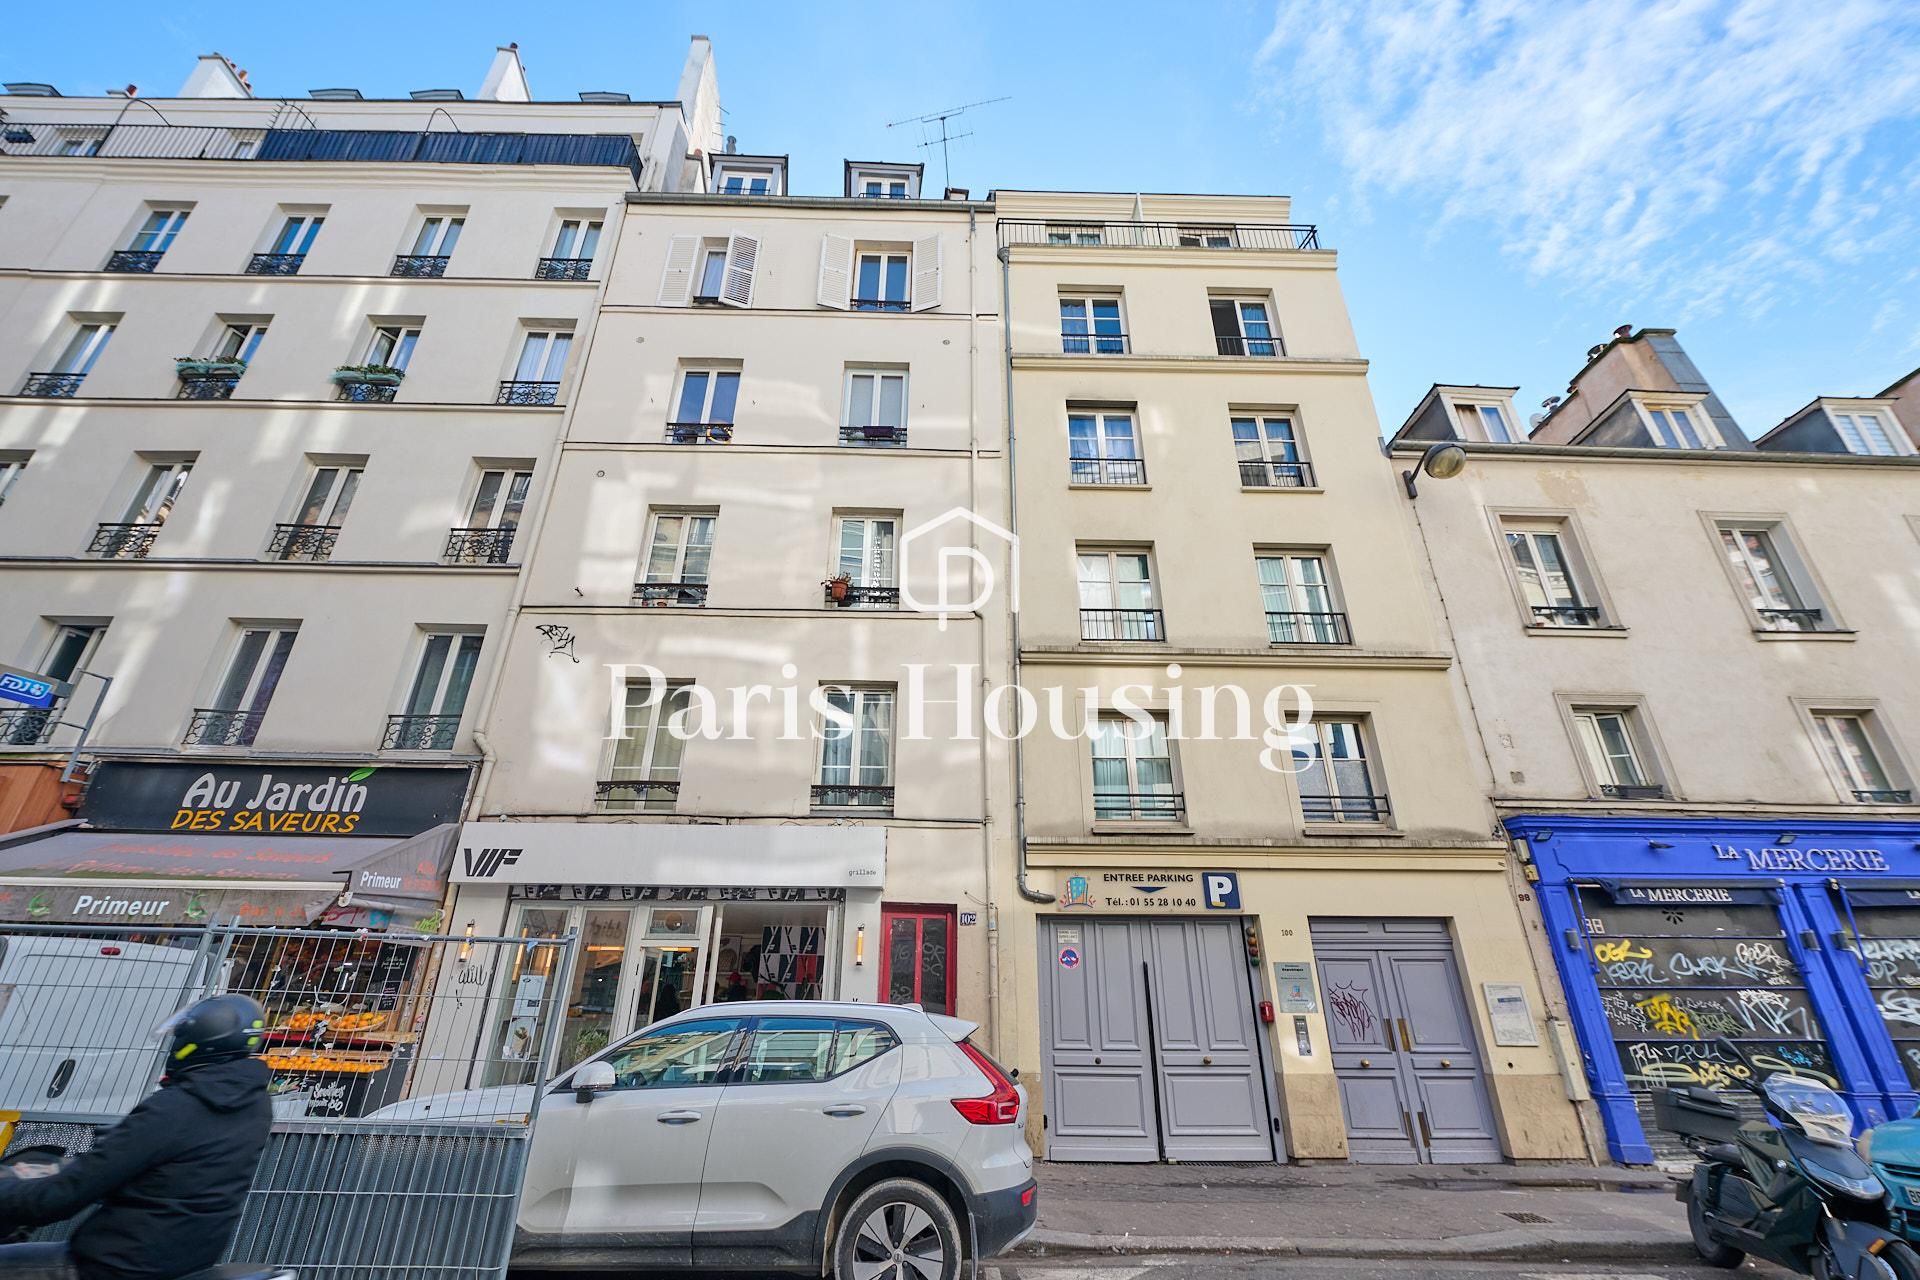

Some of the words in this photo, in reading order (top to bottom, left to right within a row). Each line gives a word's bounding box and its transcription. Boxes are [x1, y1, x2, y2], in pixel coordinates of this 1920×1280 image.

[0, 676, 31, 692] FDJ
[181, 772, 241, 809] Au
[246, 774, 368, 813] Jardin
[171, 809, 222, 830] DES
[229, 811, 360, 833] SAVEURS
[464, 848, 523, 877] VIF
[1713, 844, 1742, 860] LA
[1746, 848, 1890, 872] MERCERIE
[360, 871, 402, 889] Primeur
[848, 869, 876, 877] grillade
[1103, 873, 1145, 882] ENTREE
[1147, 874, 1194, 883] PARKING
[1208, 876, 1233, 907] P
[1518, 894, 1531, 902] 98
[1629, 888, 1646, 899] LA
[1648, 887, 1732, 902] MERCERIE
[72, 895, 170, 916] Primeur
[1130, 898, 1140, 907] 01
[1144, 898, 1154, 907] 55
[1158, 898, 1169, 907] 28
[1172, 898, 1181, 907] 10
[1185, 898, 1196, 907] 40
[961, 913, 976, 926] 102
[1281, 929, 1293, 937] 100
